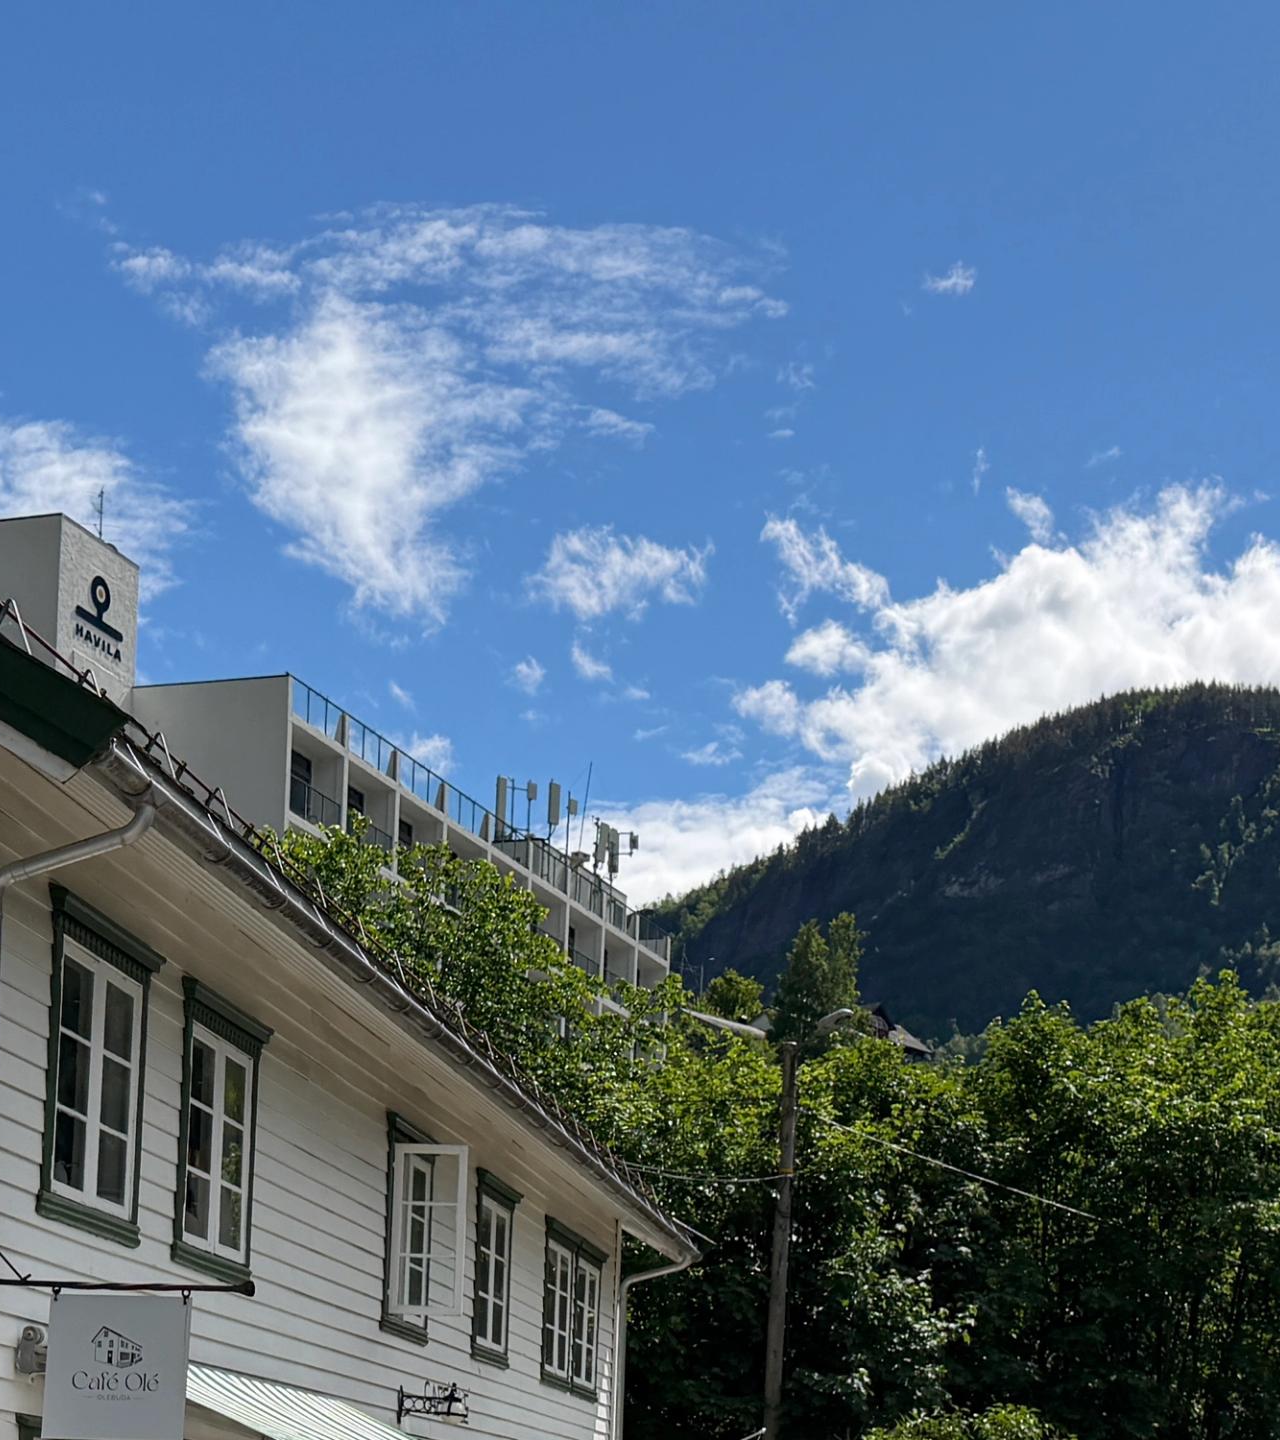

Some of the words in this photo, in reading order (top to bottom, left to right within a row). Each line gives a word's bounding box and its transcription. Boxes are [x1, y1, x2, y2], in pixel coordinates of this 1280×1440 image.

[76, 623, 121, 662] HAVILA
[72, 1370, 119, 1391] Café
[125, 1372, 159, 1392] Olé
